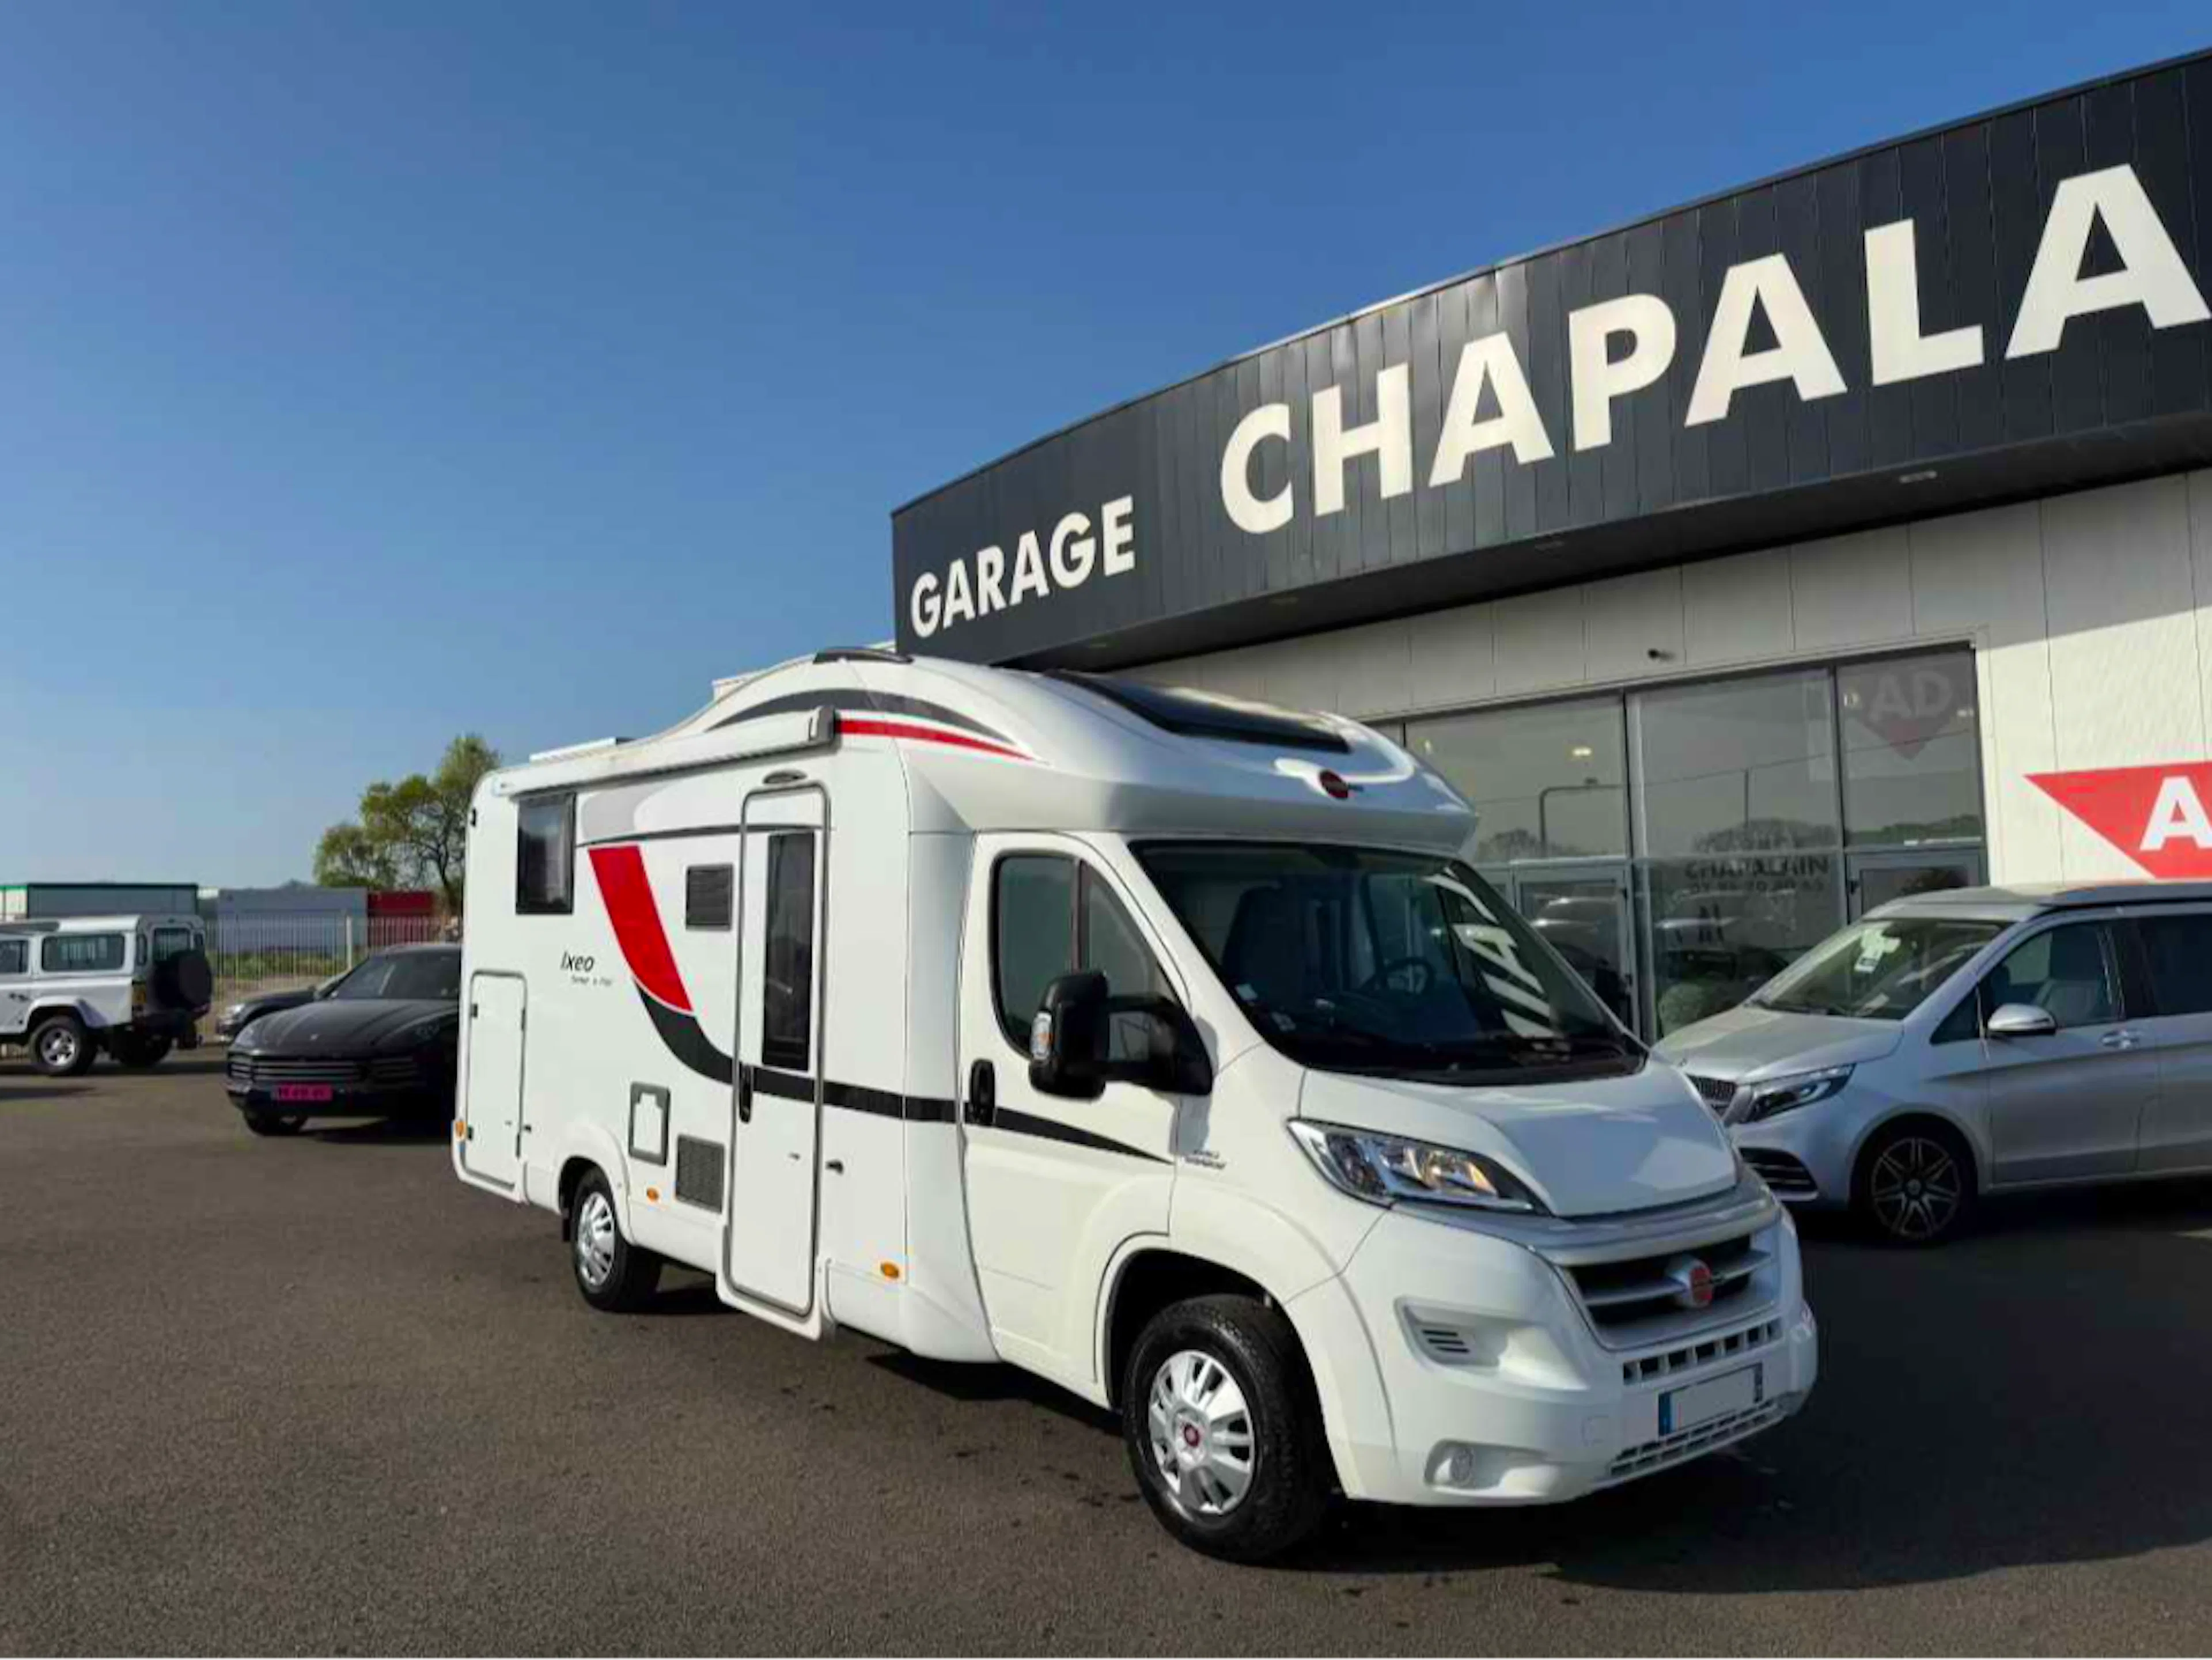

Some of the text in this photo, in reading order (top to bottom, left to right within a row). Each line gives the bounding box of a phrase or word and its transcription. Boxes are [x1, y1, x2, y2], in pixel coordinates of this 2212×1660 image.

[910, 162, 2212, 638] GARAGE CHAPALA
[1868, 670, 1954, 722] AD
[2139, 775, 2212, 851] A
